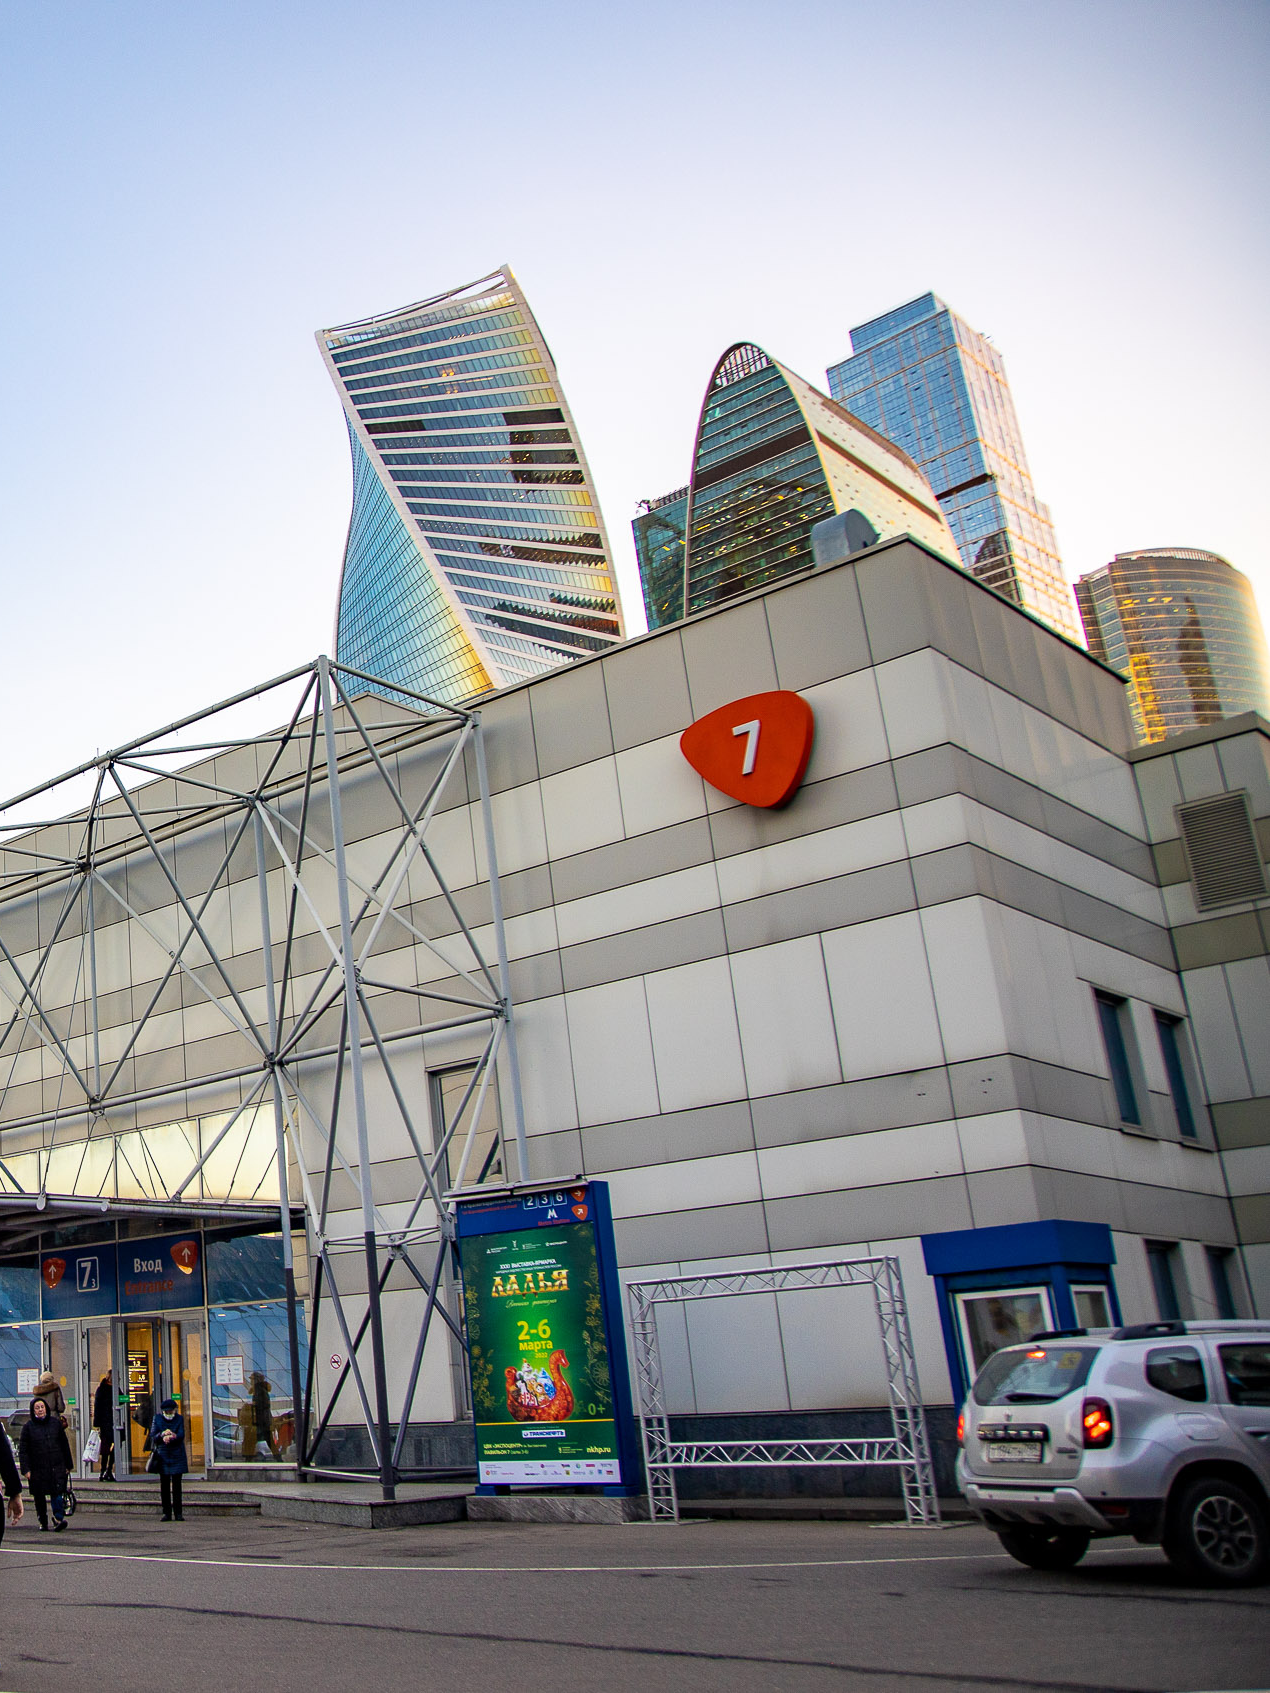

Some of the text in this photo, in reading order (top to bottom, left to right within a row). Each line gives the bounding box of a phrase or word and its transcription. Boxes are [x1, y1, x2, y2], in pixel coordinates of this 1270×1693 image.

[732, 719, 761, 776] 7
[527, 1192, 563, 1206] 2 3 6
[134, 1258, 162, 1273] Вход
[80, 1261, 96, 1288] 7 3
[125, 1279, 173, 1296] Entrance
[517, 1319, 551, 1340] 2-6
[519, 1340, 553, 1352] марта
[588, 1403, 606, 1415] 0+
[586, 1445, 611, 1455] nkhp.ru
